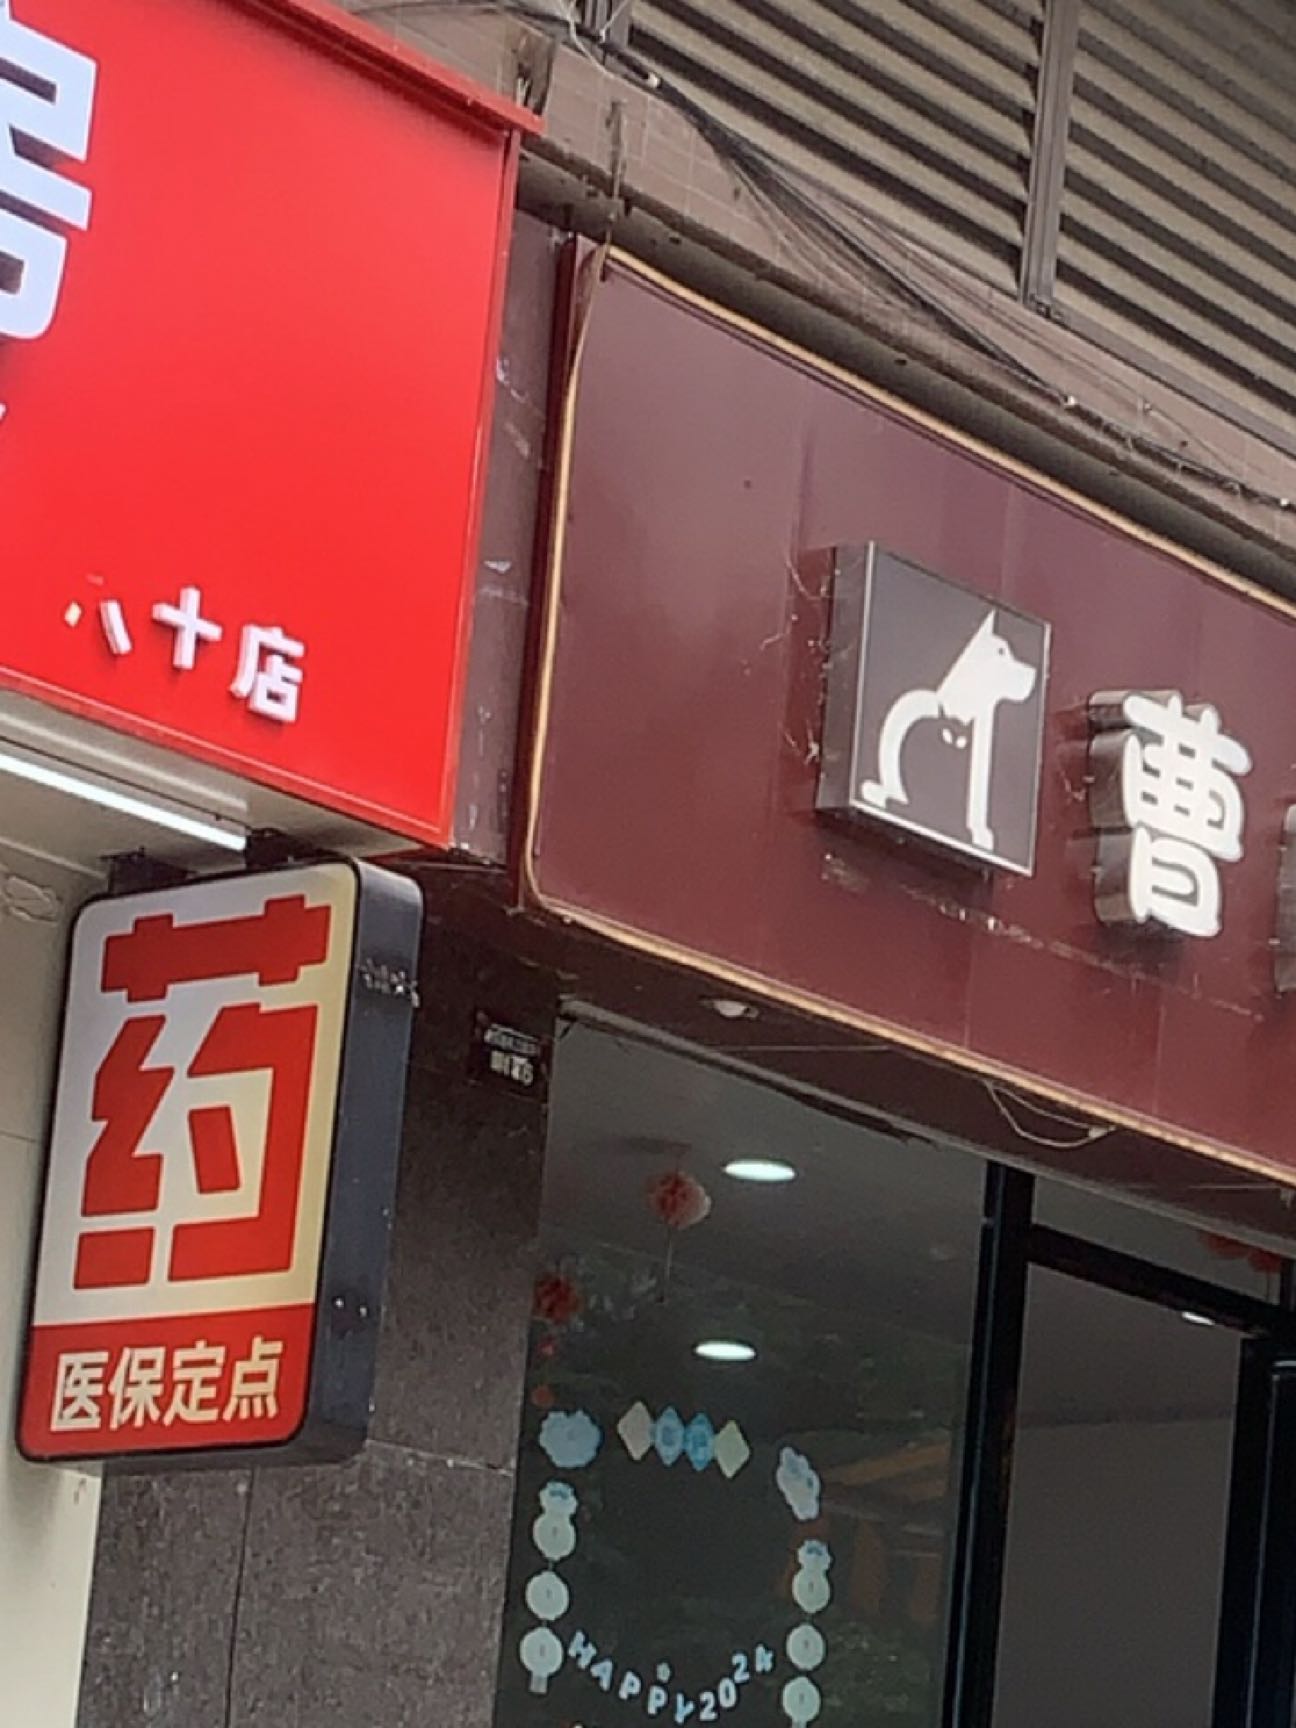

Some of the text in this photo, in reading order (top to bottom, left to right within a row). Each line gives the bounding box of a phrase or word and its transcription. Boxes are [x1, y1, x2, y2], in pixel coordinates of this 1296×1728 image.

[73, 894, 332, 1290] 药
[50, 1335, 284, 1433] 医保定点
